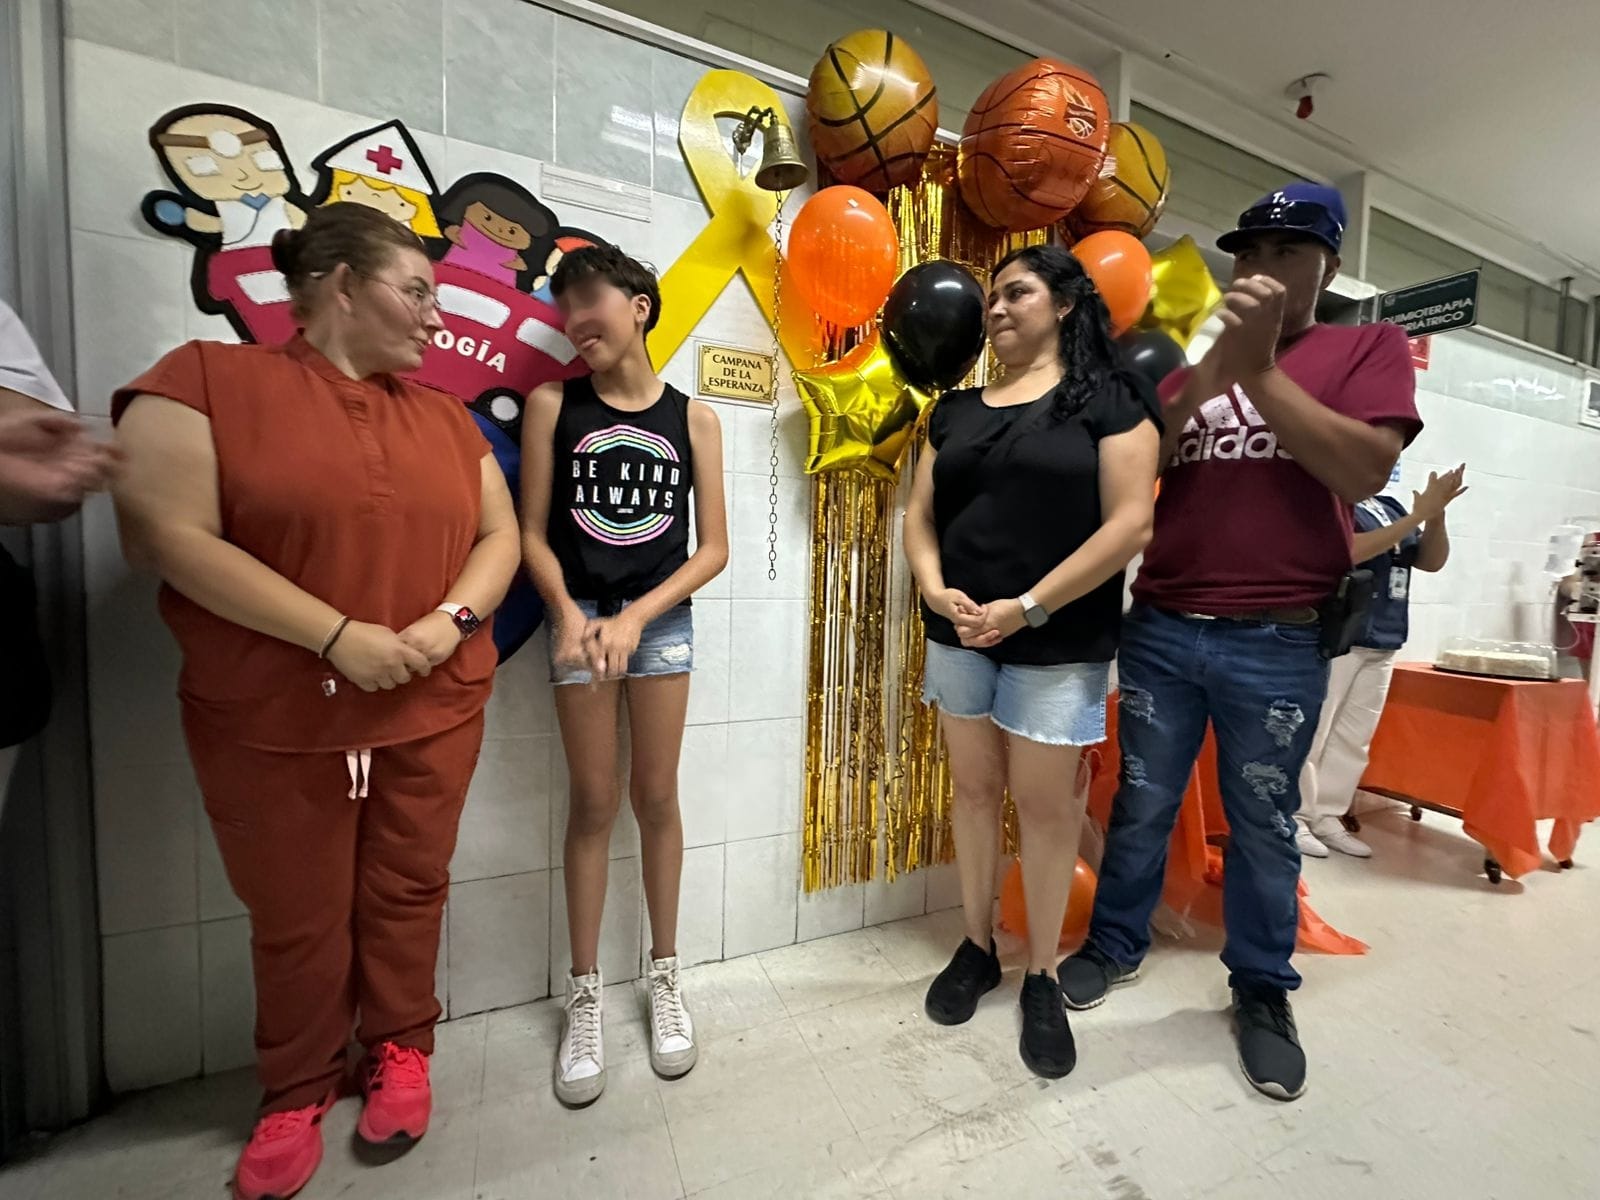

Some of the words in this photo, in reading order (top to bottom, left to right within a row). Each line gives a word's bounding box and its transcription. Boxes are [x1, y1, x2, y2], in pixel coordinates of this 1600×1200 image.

[430, 329, 507, 373] OGÍA
[712, 354, 762, 370] CAMPANA
[708, 377, 765, 393] ESPERANZA
[723, 367, 737, 378] DE
[739, 370, 752, 380] LA
[1171, 425, 1294, 467] dida
[572, 459, 598, 478] BE
[620, 462, 680, 486] KIND
[575, 484, 674, 509] ALWAYS
